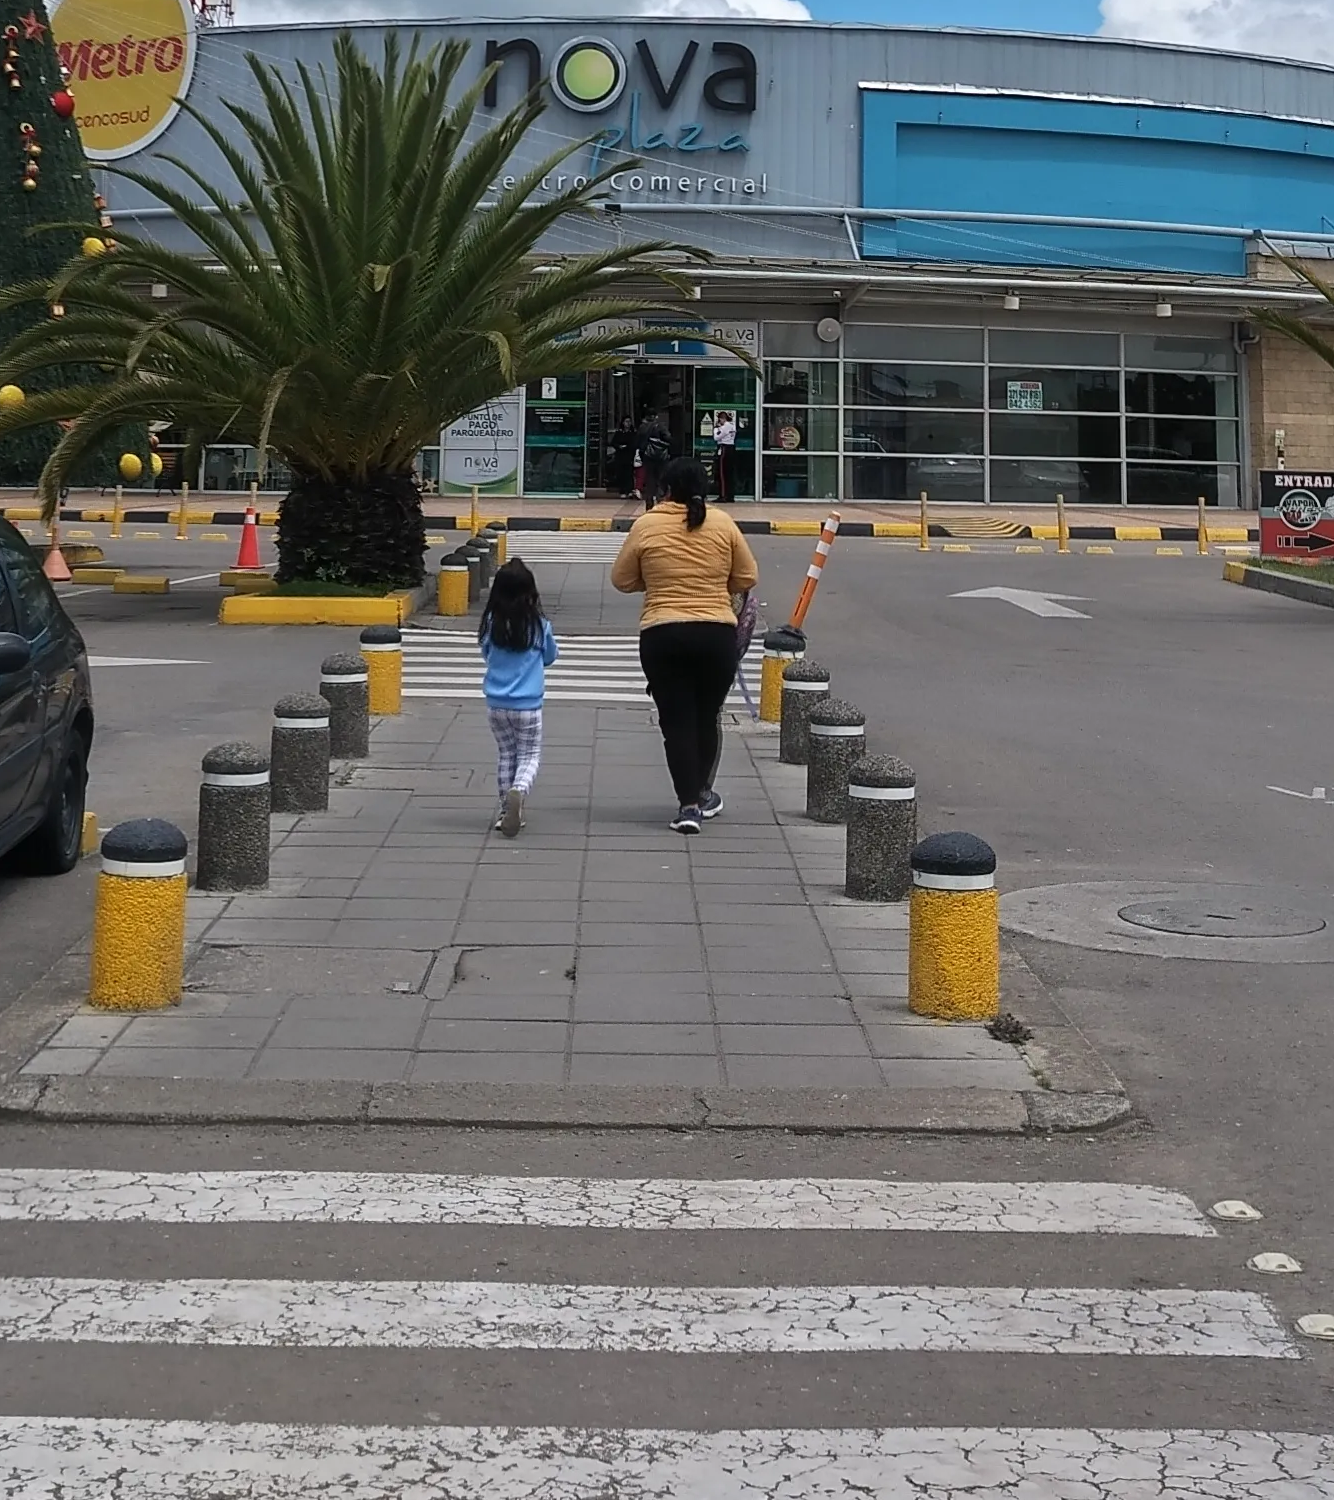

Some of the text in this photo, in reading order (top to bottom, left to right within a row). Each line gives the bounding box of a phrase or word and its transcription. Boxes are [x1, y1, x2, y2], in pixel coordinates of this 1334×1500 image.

[58, 34, 183, 82] Metro
[483, 36, 757, 112] nova
[76, 106, 150, 128] cencosud
[587, 91, 750, 180] plaza
[610, 173, 767, 193] Comercial
[713, 327, 754, 340] nova
[670, 340, 679, 352] 1
[451, 429, 513, 437] PARQUEADERO
[469, 421, 497, 429] PAGO
[464, 457, 498, 467] nova
